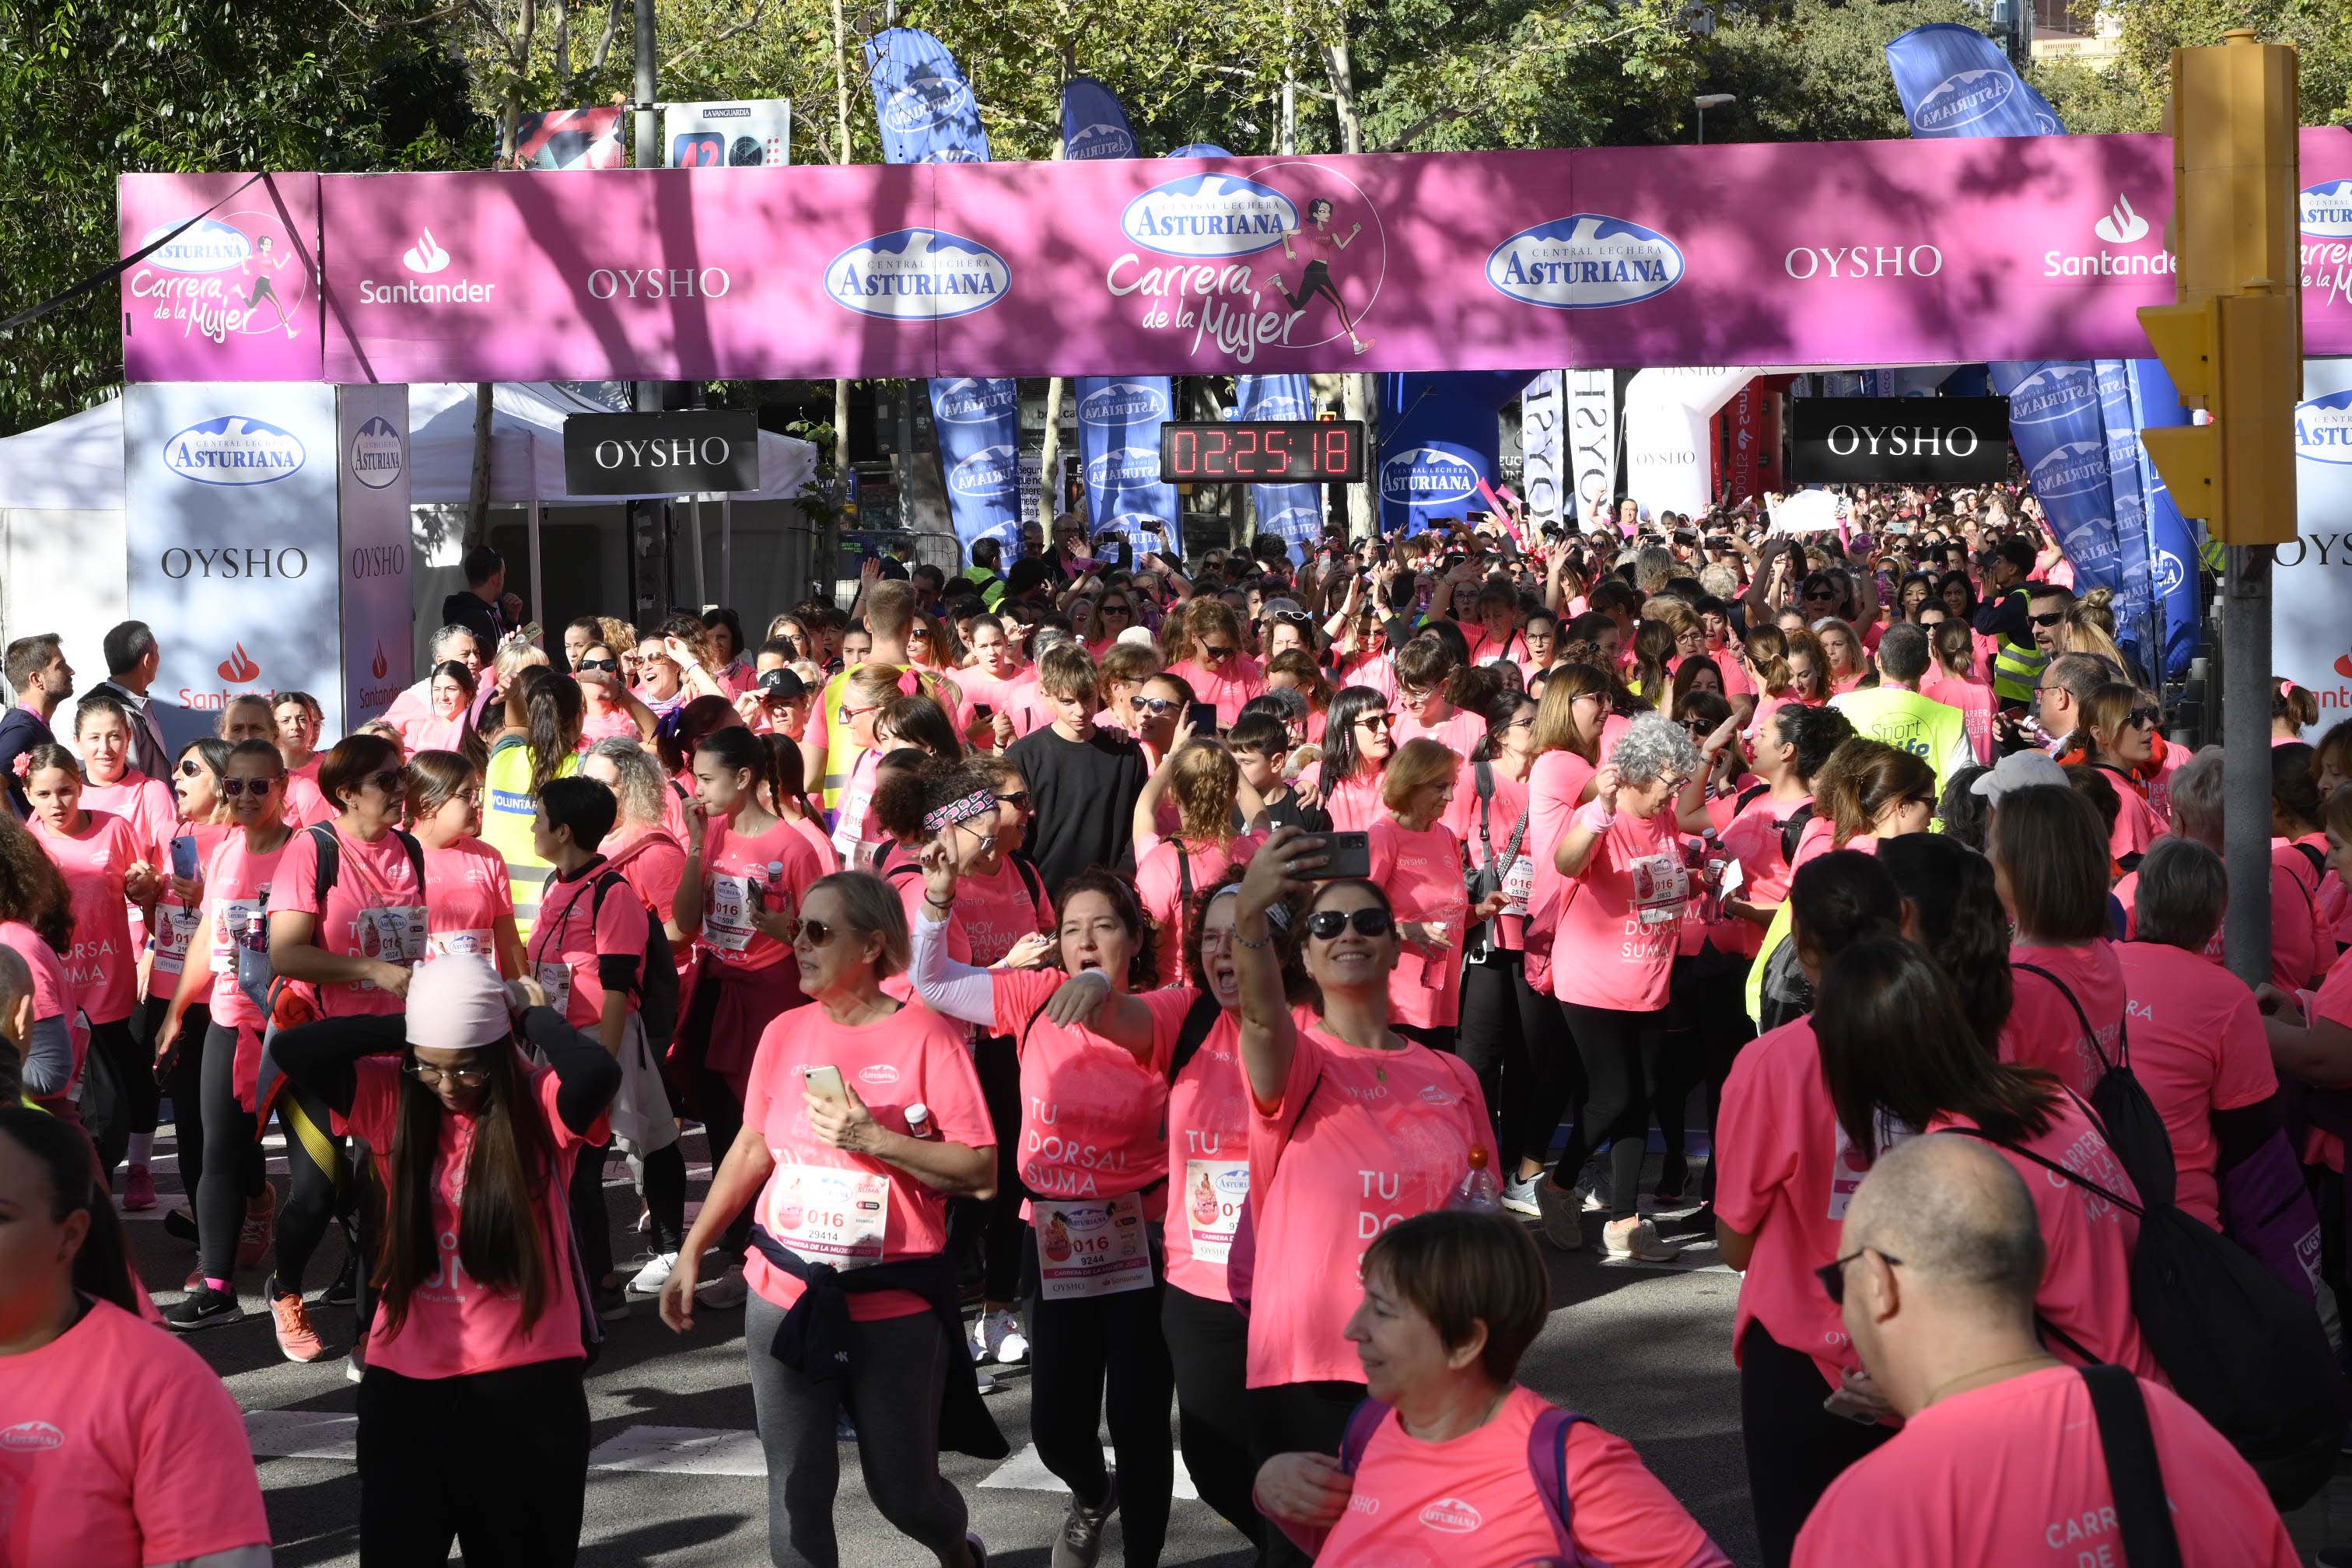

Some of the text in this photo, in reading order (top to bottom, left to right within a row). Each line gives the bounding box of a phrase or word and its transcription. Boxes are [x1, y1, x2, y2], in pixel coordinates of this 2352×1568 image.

[1136, 205, 1286, 236] ASTURIANA
[1531, 245, 1662, 257] CENTRAL LECHERA
[1784, 244, 1943, 279] OYSHO
[867, 259, 991, 270] CENTRAL LECHERA
[1107, 254, 1252, 297] Carrera
[1501, 250, 1669, 285] ASTURIANA
[2316, 265, 2330, 287] la
[131, 268, 224, 299] Carrera
[359, 278, 495, 304] Santander
[587, 267, 731, 299] OYSHO
[838, 263, 998, 296] ASTURIANA
[153, 296, 260, 344] de la Mujer
[1142, 291, 1307, 364] de la Mujer
[594, 436, 730, 470] OYSHO
[1174, 430, 1349, 473] 02:25:18
[1827, 424, 1979, 458] OYSHO
[174, 441, 296, 469] ASTURIANA
[355, 443, 401, 472] ASTURIANA
[1383, 471, 1472, 492] ASTURIANA
[160, 547, 309, 579] OYSHO
[352, 544, 405, 580] OYSHO
[1965, 717, 1986, 726] DE LA
[1399, 858, 1427, 866] OYSHO
[1510, 878, 1532, 889] 016
[1655, 879, 1673, 891] 016
[716, 902, 739, 916] 016
[966, 921, 993, 933] HOY
[1625, 919, 1681, 936] DORSAL
[1621, 942, 1669, 959] SUMA
[1031, 1096, 1058, 1125] TU
[1185, 1129, 1220, 1155] TU
[1027, 1162, 1099, 1196] SUMA
[1358, 1170, 1399, 1201] TU
[807, 1209, 844, 1228] 016
[782, 1237, 810, 1249] CARRERA
[830, 1245, 853, 1255] MUJER
[808, 1229, 838, 1241] 29414
[1073, 1236, 1109, 1253] 016
[1201, 1233, 1229, 1241] CARRERA
[1080, 1255, 1104, 1265] 9244
[1052, 1283, 1085, 1292] OYSHO
